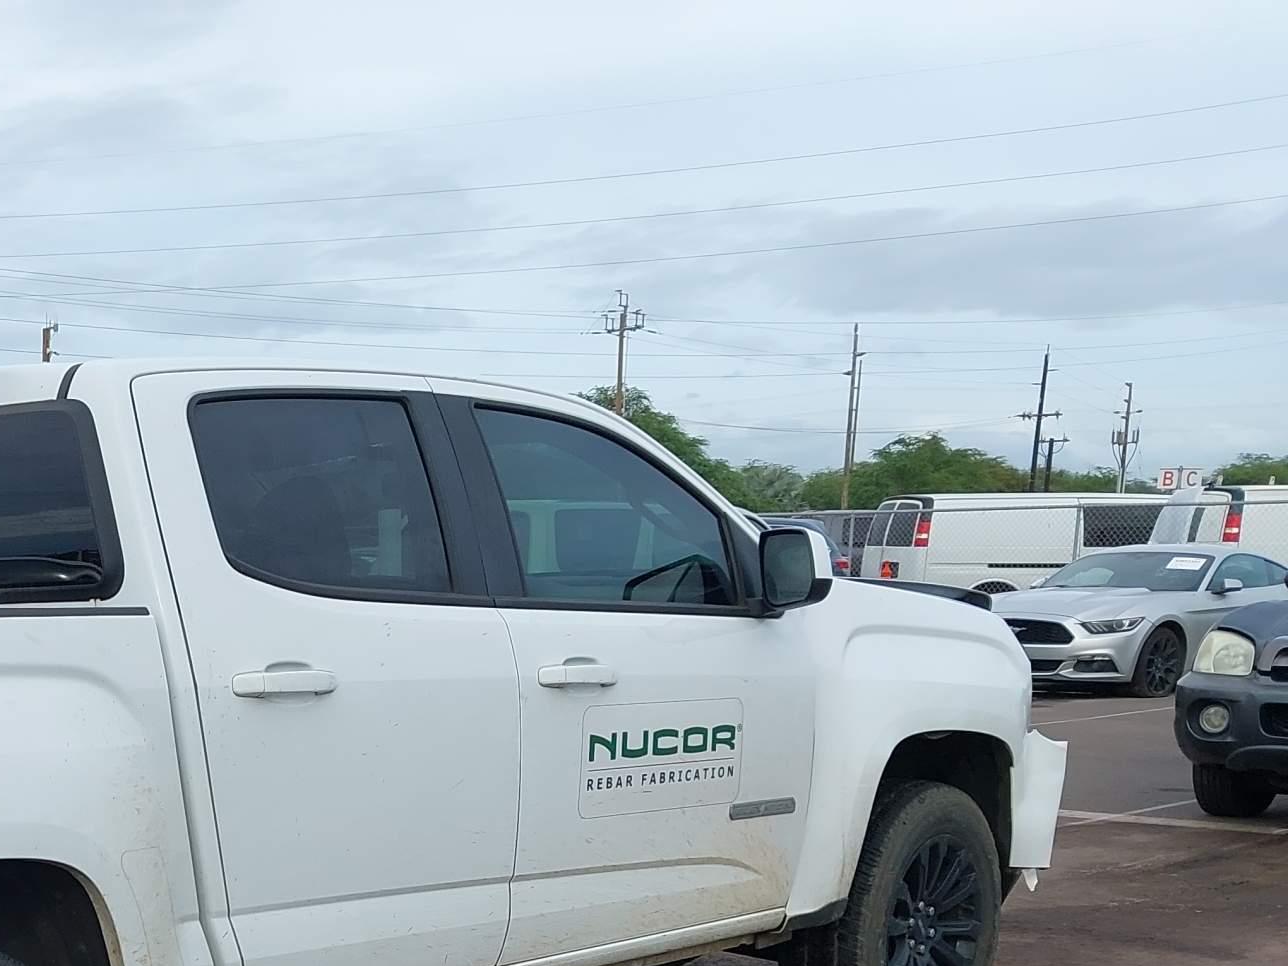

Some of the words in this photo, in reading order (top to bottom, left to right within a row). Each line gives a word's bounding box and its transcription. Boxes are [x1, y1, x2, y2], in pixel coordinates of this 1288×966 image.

[1162, 471, 1174, 487] B
[1186, 471, 1198, 487] C
[588, 724, 736, 762] NUCOR
[586, 774, 633, 792] REBAR
[641, 765, 735, 787] FABRICATION
